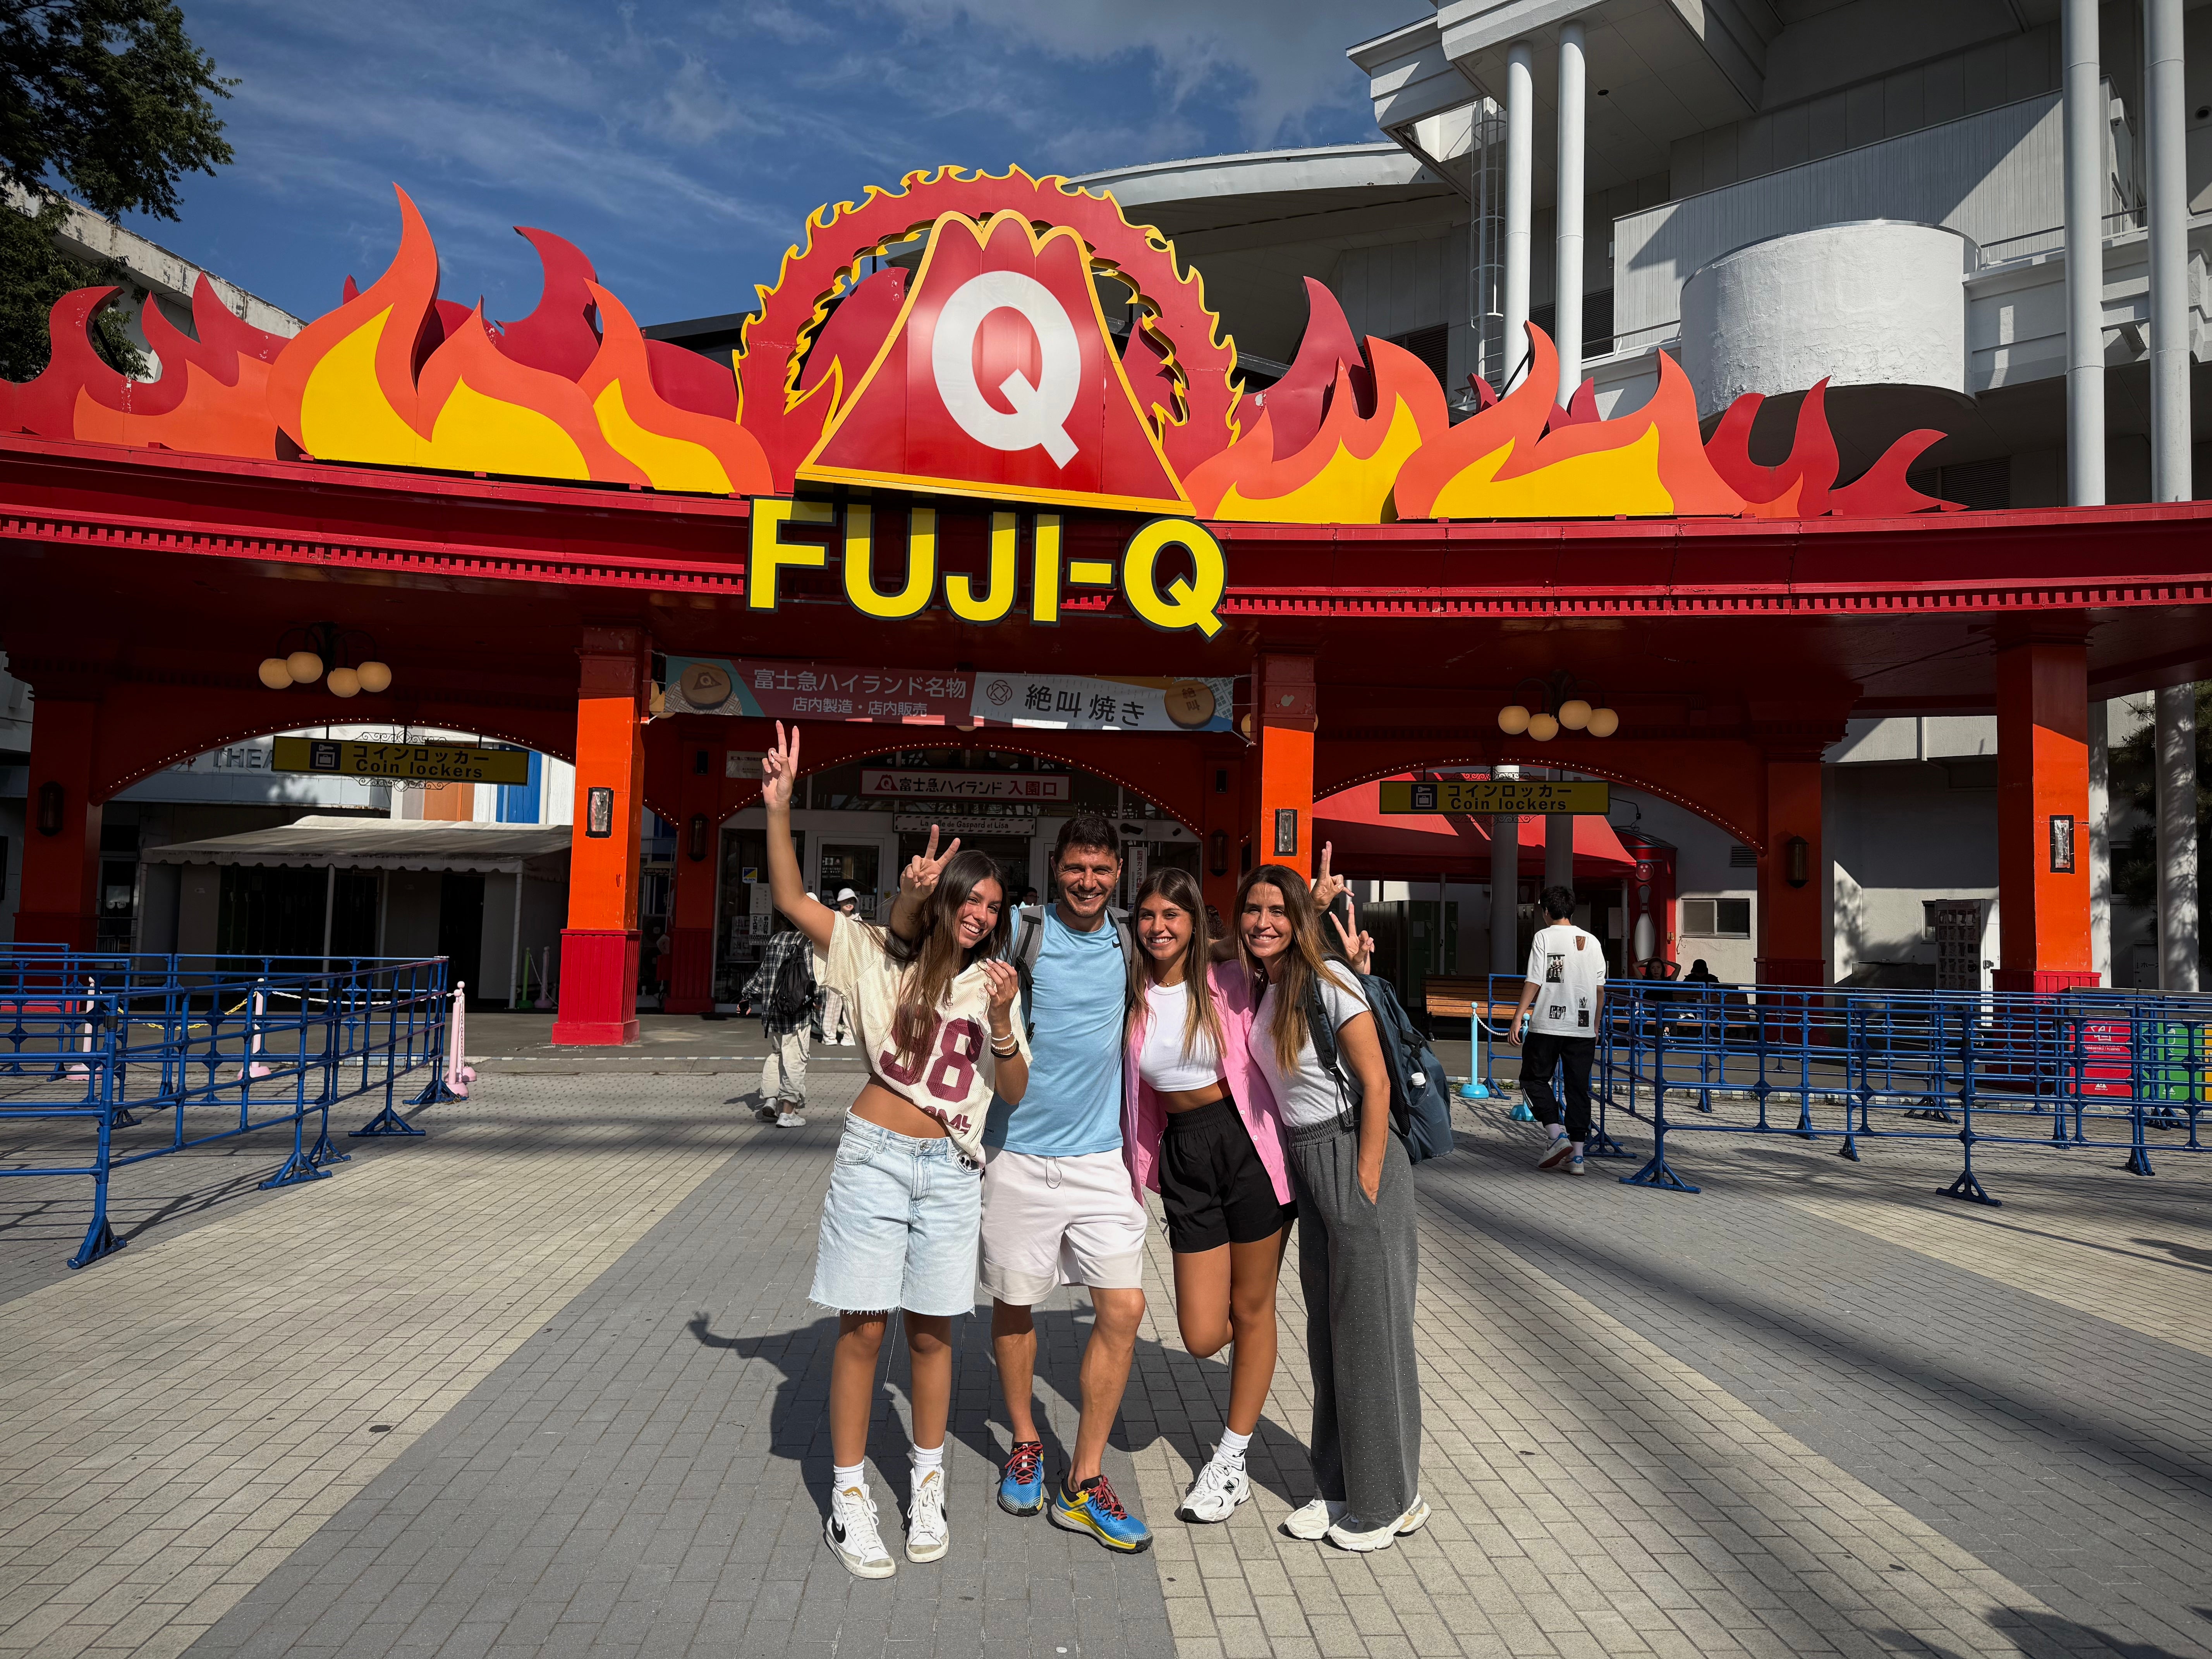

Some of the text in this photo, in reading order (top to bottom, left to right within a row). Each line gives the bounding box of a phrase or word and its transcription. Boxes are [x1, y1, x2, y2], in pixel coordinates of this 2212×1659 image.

[932, 270, 1081, 469] Q
[748, 496, 1227, 642] FUJI-Q
[700, 675, 713, 685] Q
[754, 668, 966, 699] 富士急ハイランド名物
[792, 697, 927, 717] 店内製造・店内販売
[1025, 683, 1145, 726] 絶叫焼き
[353, 745, 489, 764] コインロッカー
[356, 759, 483, 778] Coin lockers
[880, 777, 892, 790] Q
[899, 778, 1057, 796] 富士急ハイランド 入園口
[1448, 785, 1572, 798] コインロッカー
[1451, 798, 1566, 810] Coin lockers
[957, 821, 985, 830] Gaspard
